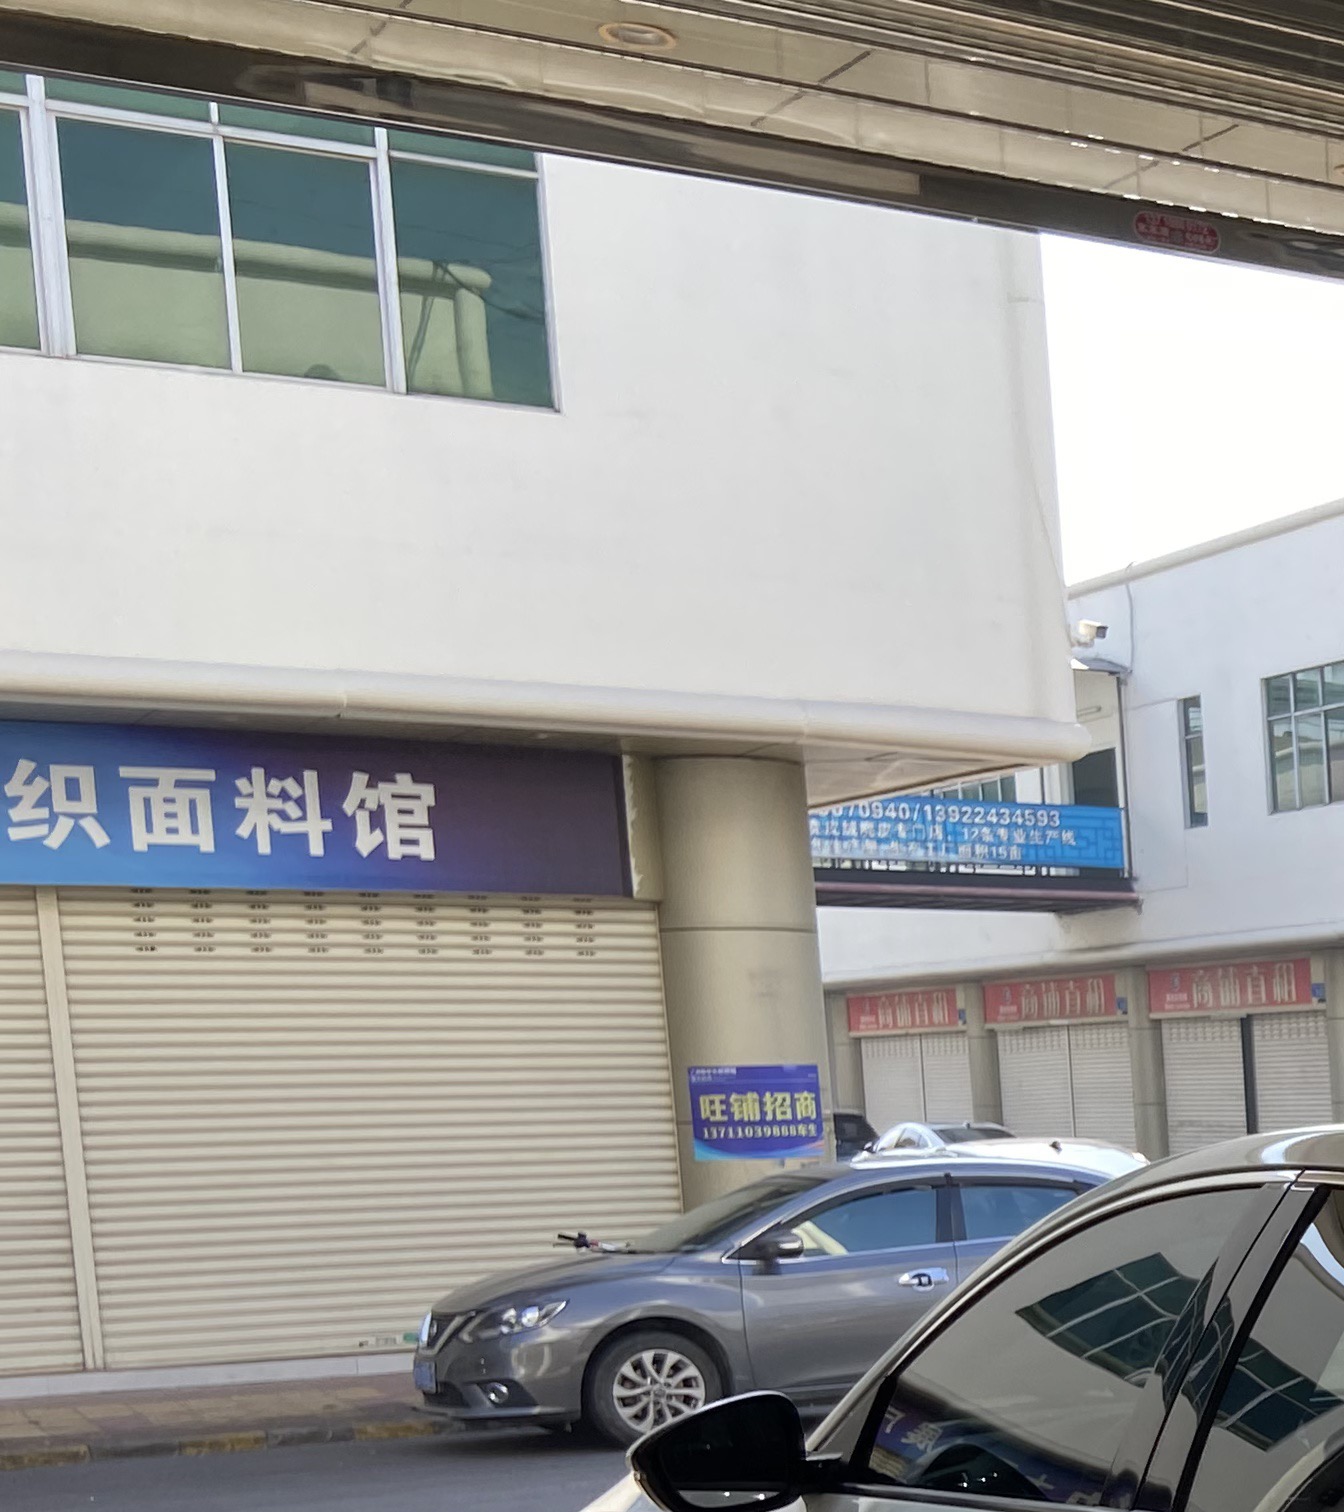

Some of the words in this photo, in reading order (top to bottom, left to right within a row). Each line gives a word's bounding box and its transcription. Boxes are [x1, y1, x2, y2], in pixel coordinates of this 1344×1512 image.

[4, 758, 437, 862] 织面料馆
[699, 1091, 817, 1122] 旺铺招商
